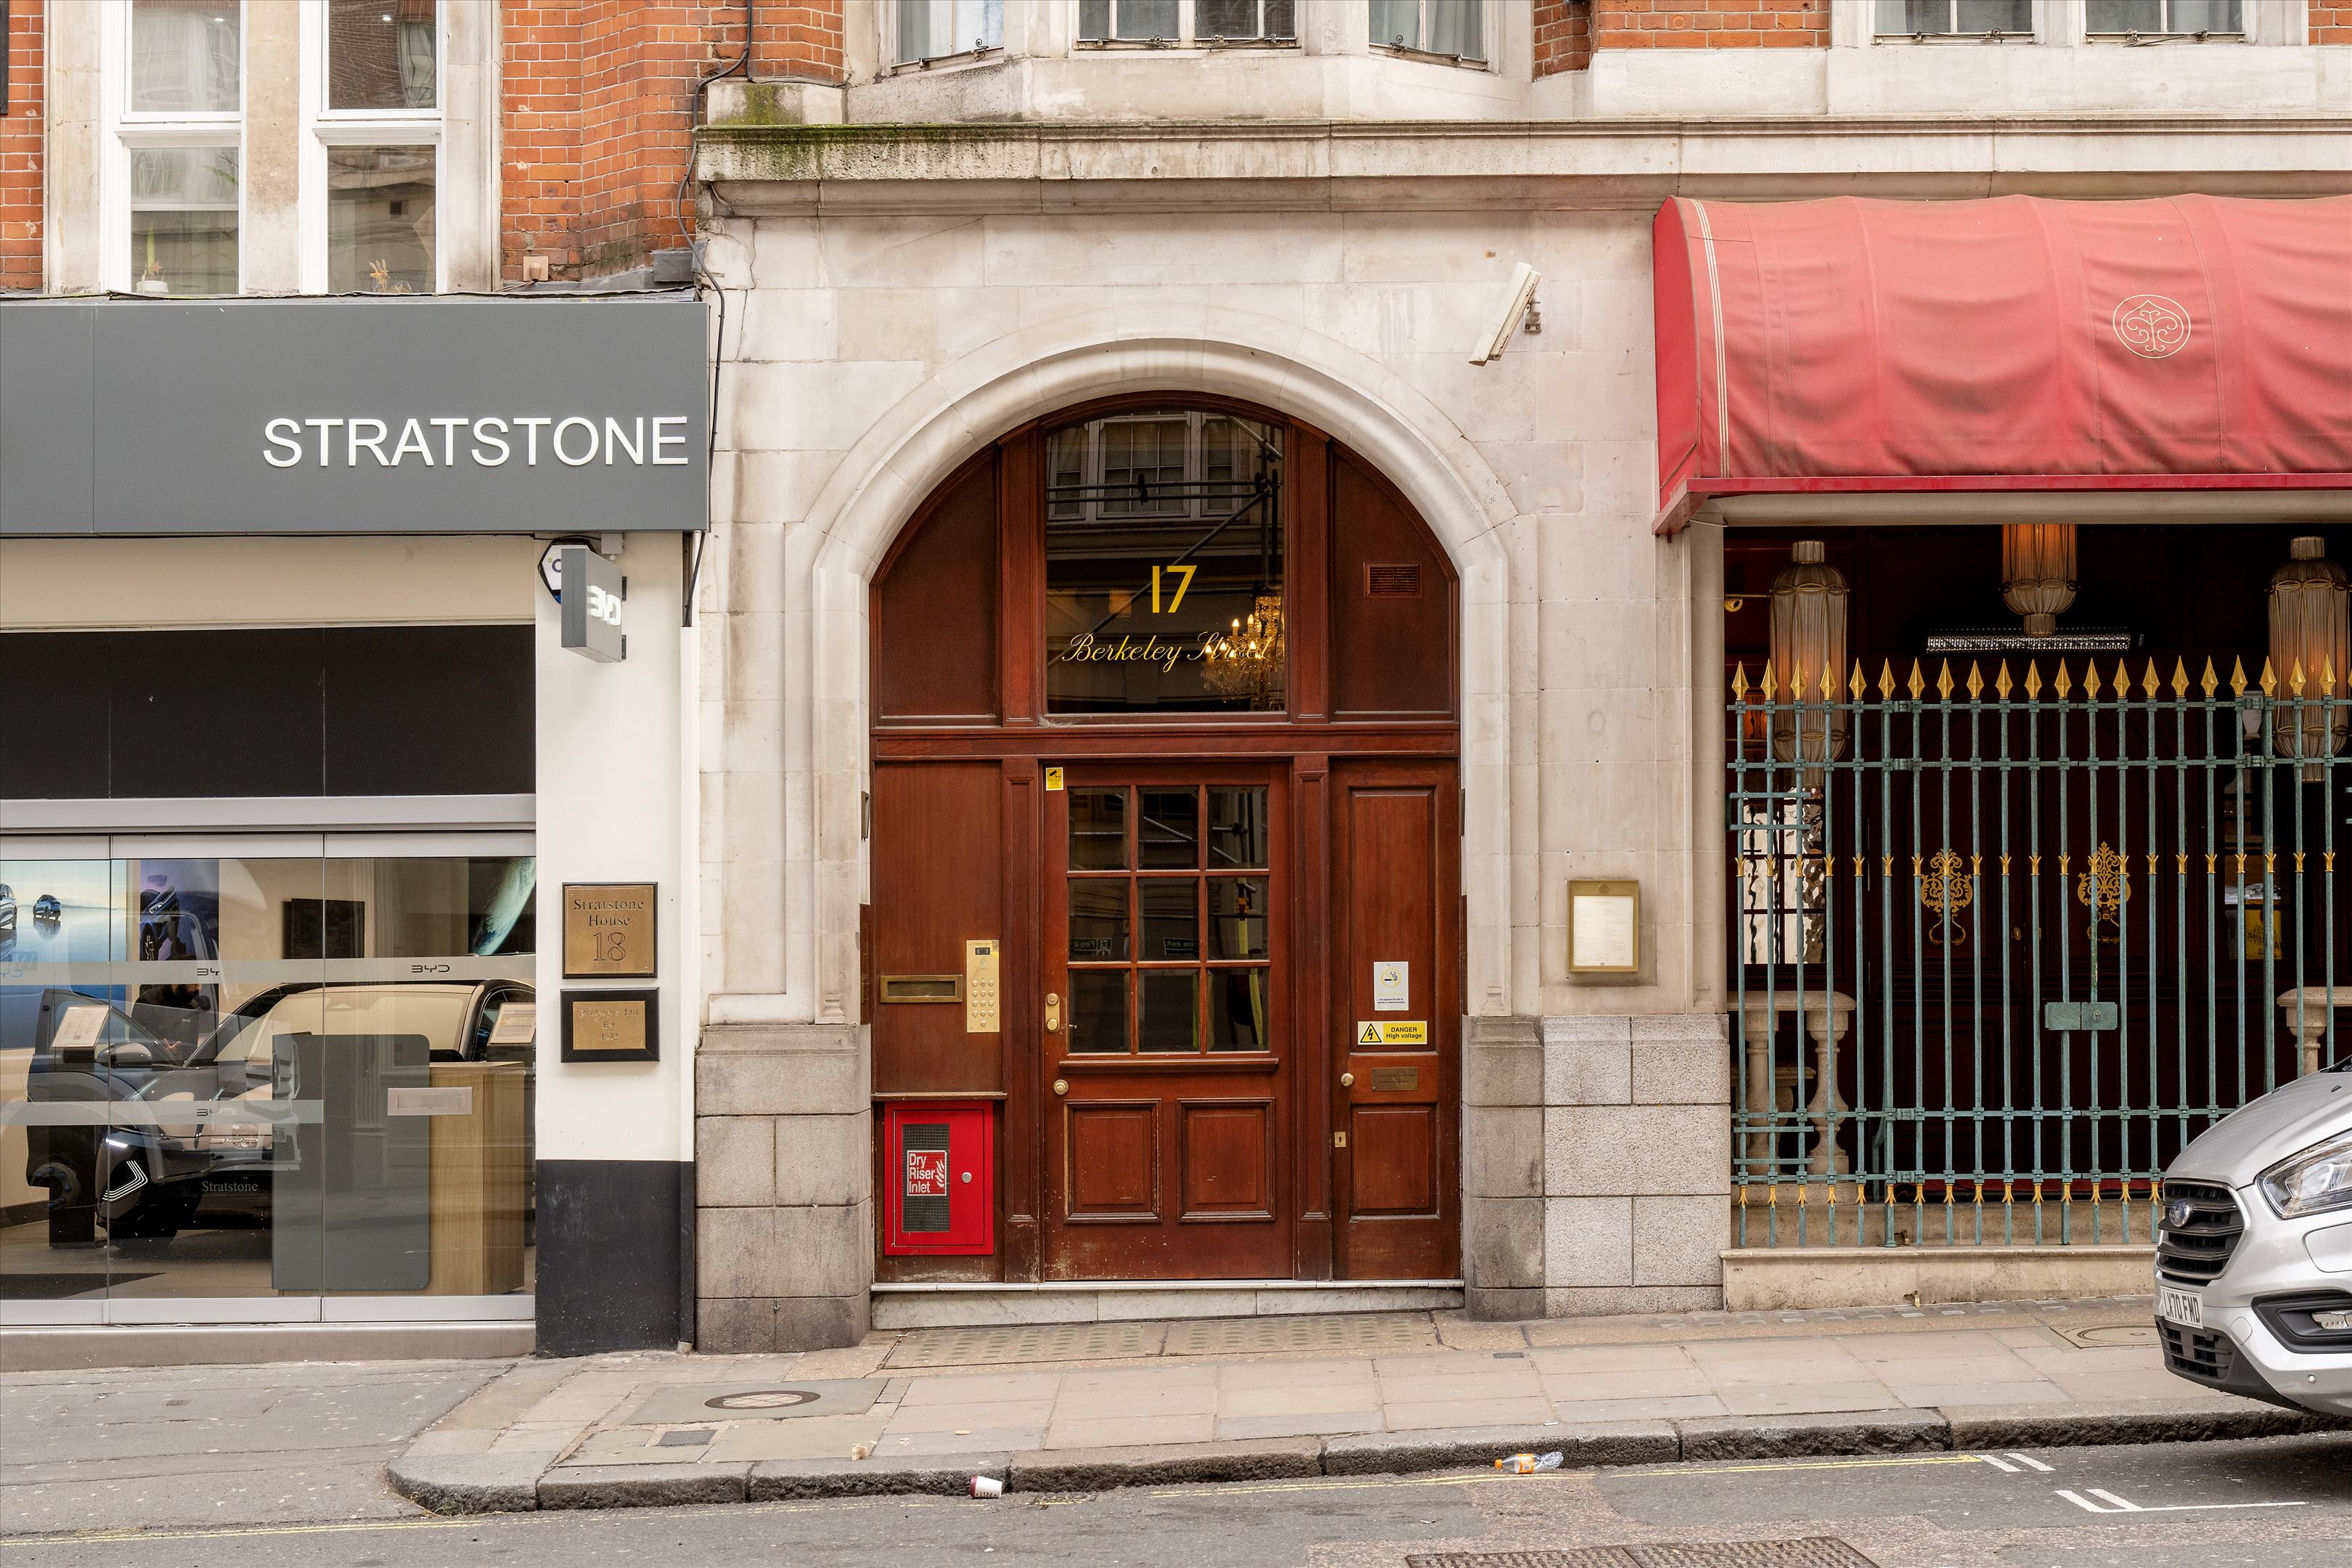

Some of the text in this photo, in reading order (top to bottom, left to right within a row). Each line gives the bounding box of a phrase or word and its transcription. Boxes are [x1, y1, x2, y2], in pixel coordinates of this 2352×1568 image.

[263, 416, 689, 467] STRATSTONE
[1151, 565, 1198, 613] 17
[1061, 630, 1273, 674] Berkeley Street
[573, 899, 644, 911] Stratstone
[589, 915, 631, 926] House
[592, 931, 626, 961] 18
[0, 969, 23, 978] YD
[579, 1008, 620, 1017] Stratstone
[909, 1153, 927, 1169] Dry
[909, 1167, 936, 1180] Riser
[201, 1180, 259, 1193] Stratstone
[909, 1180, 931, 1193] Inlet
[2163, 1290, 2201, 1323] LX70 FMD
